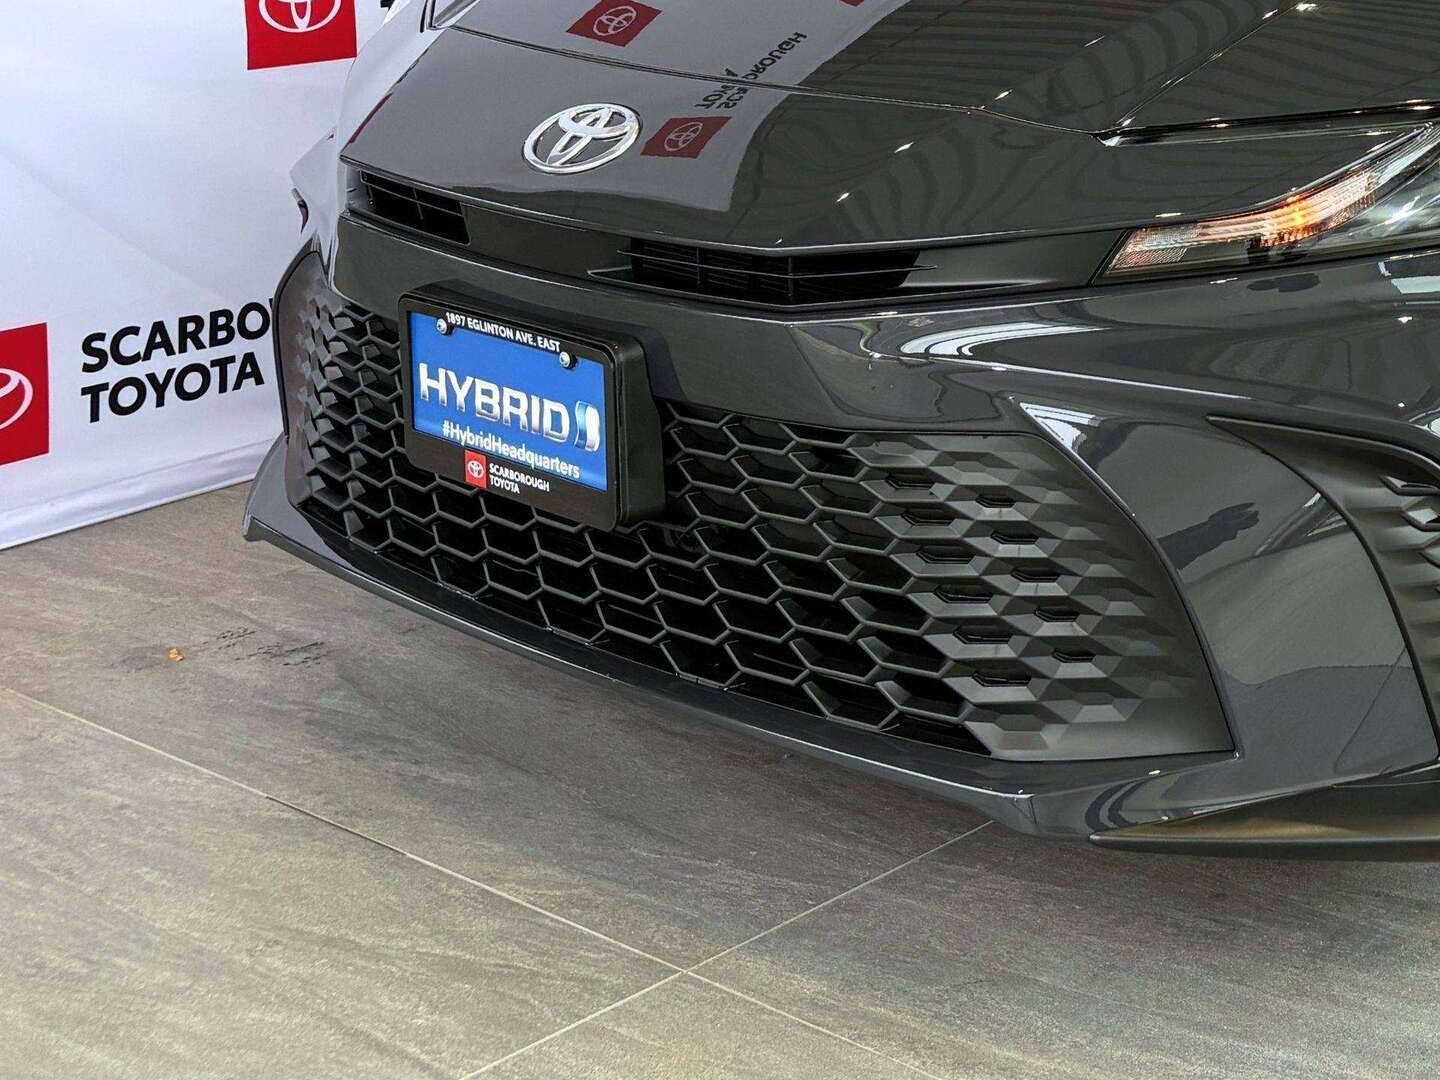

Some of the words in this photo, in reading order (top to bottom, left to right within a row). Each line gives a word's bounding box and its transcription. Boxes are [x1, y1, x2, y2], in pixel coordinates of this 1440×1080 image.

[81, 298, 273, 373] SCARBO
[446, 312, 466, 327] 1897
[467, 316, 514, 339] EGLINTON
[515, 330, 537, 348] AVE.
[537, 335, 560, 352] EAST
[81, 351, 264, 423] TOYOTA
[419, 362, 570, 445] HYBRID
[441, 420, 580, 479] #HybridHeadquarters
[489, 463, 550, 493] SCARBOROUGH
[490, 475, 520, 495] TOYOTA
